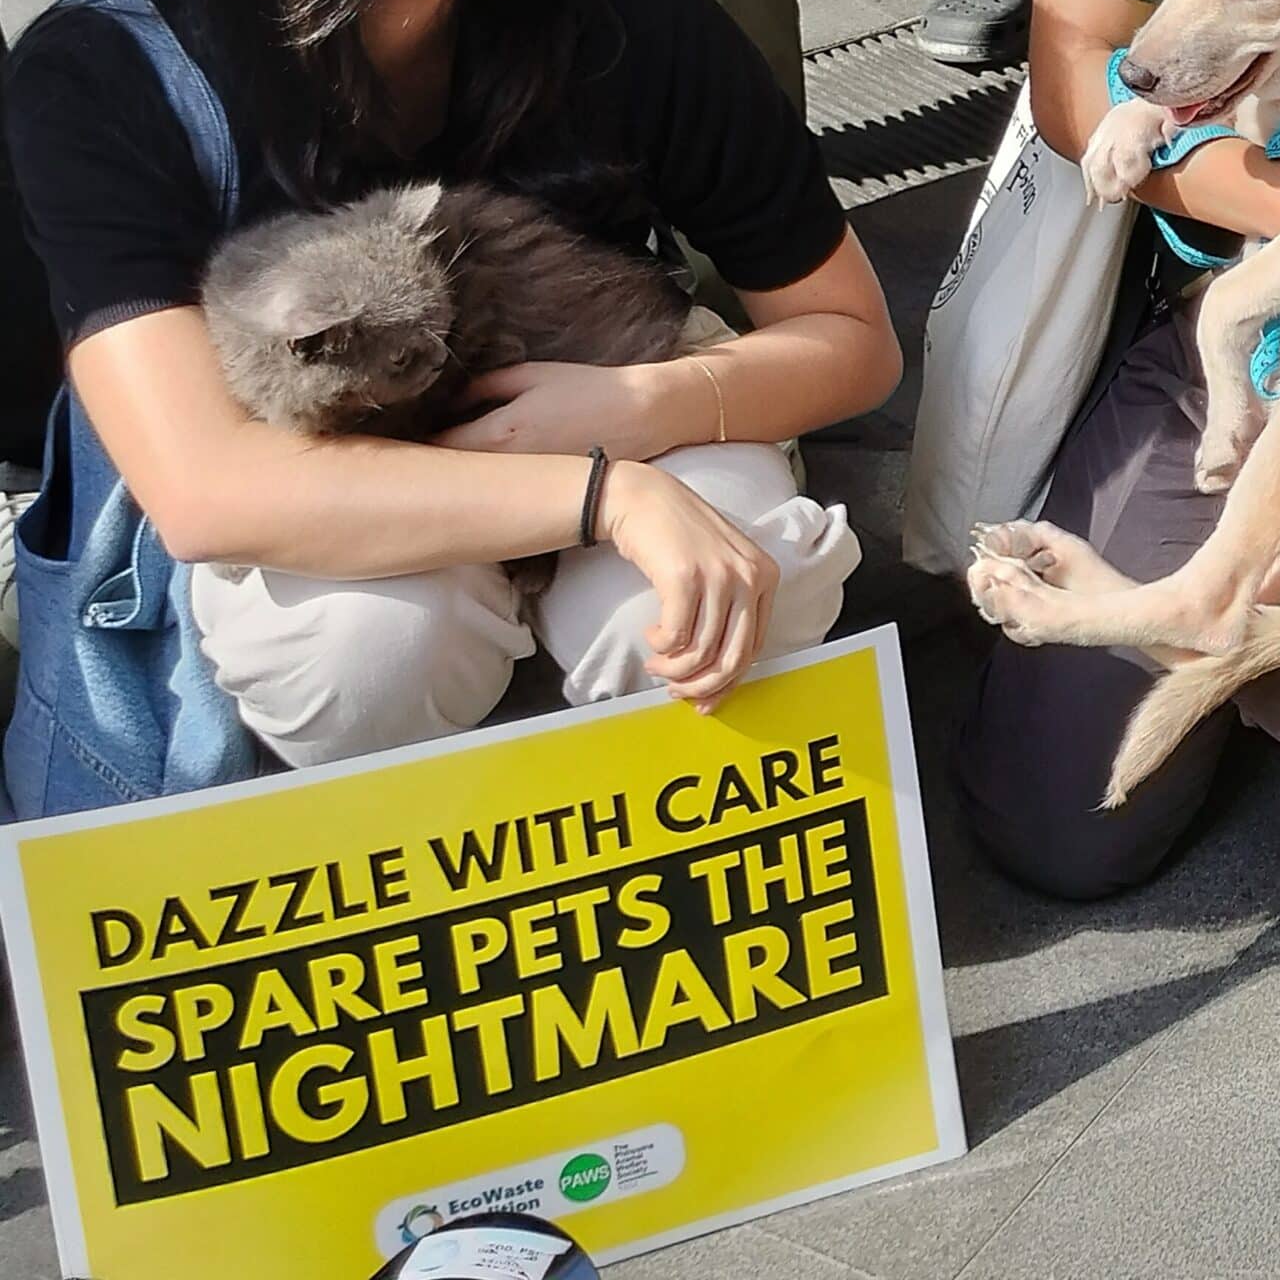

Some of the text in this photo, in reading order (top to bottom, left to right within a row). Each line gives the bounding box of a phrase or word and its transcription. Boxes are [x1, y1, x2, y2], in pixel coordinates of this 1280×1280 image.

[91, 734, 846, 970] DAZZLE WITH CARE
[115, 819, 854, 1072] SPARE PETS THE
[123, 898, 866, 1184] NIGHTMARE
[448, 1178, 544, 1215] EcoWaste
[560, 1165, 610, 1191] PAWS
